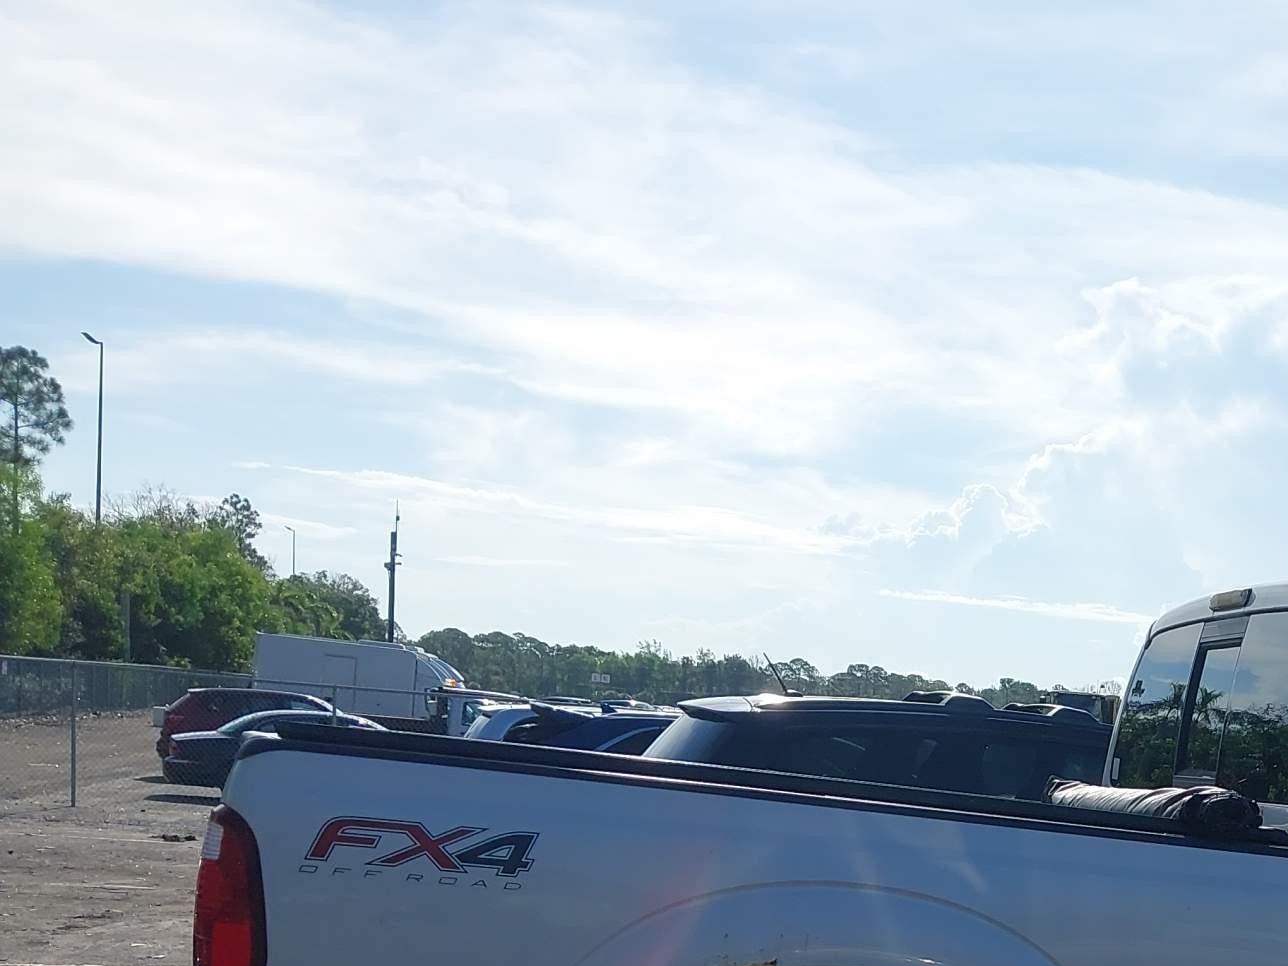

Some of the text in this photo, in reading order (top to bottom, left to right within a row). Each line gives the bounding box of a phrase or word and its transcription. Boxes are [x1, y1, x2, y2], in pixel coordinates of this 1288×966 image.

[304, 815, 541, 878] FX4
[298, 864, 522, 891] OFF ROAD
